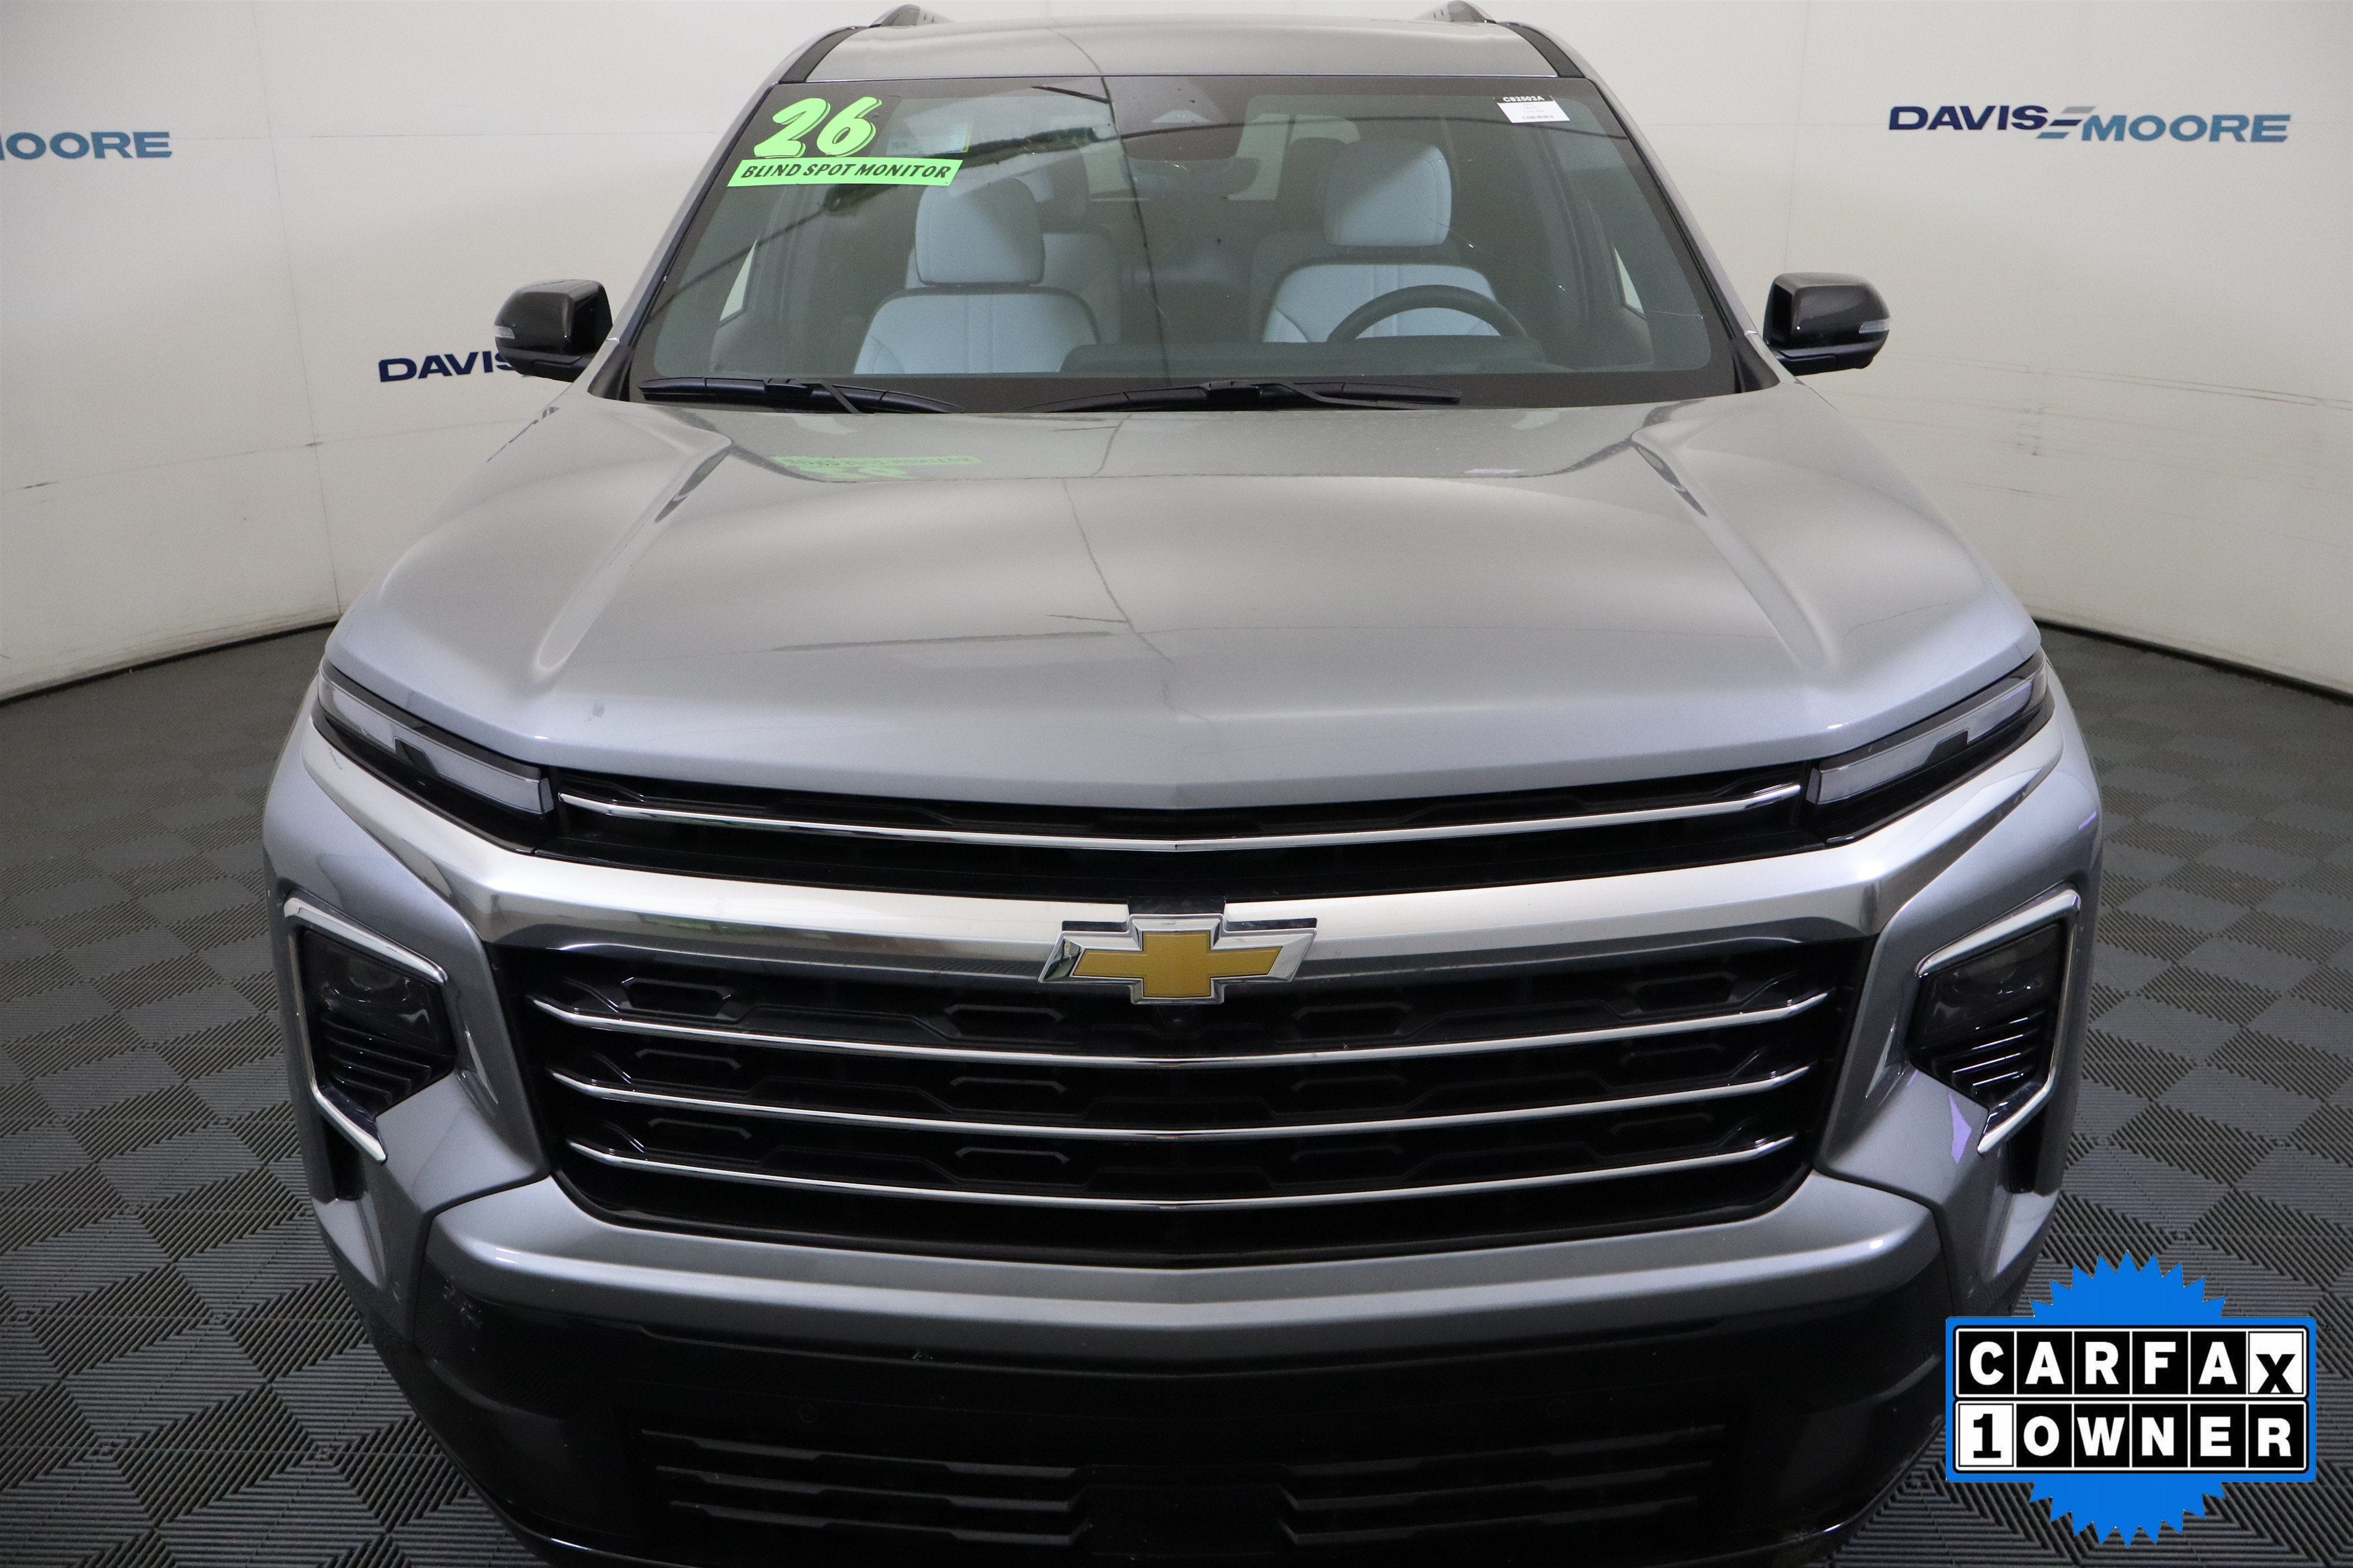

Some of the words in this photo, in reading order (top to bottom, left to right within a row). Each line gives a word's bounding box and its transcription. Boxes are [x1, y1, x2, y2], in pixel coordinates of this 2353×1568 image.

[753, 96, 882, 158] 26
[1888, 105, 2050, 130] DAVIS
[2081, 114, 2292, 142] MOORE
[0, 132, 172, 160] OORE
[740, 164, 801, 179] BLIND
[802, 163, 855, 176] SPOT
[854, 164, 951, 179] MONITOR
